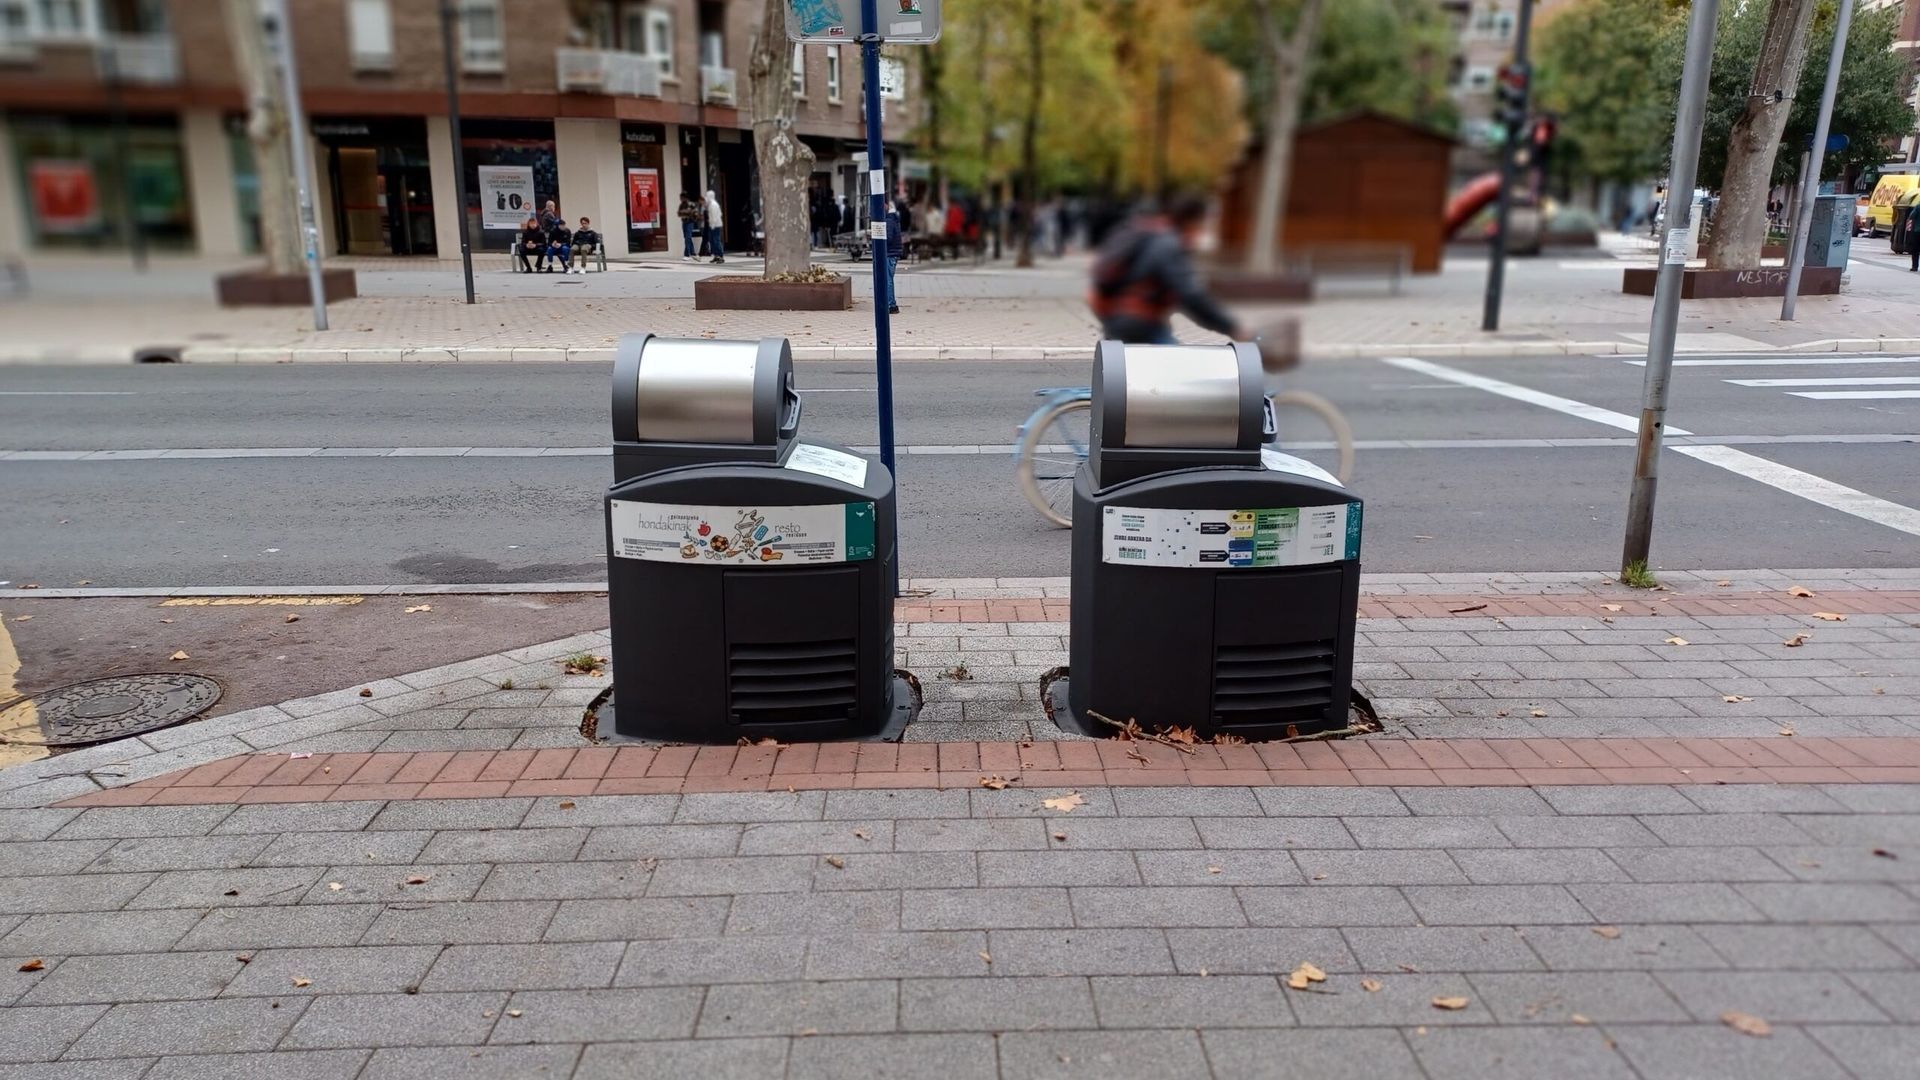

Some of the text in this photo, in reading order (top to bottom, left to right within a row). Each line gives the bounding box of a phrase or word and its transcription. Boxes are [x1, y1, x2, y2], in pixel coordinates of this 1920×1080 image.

[1737, 270, 1788, 285] NESTOR
[638, 512, 692, 531] hondakinak
[774, 522, 801, 533] resto
